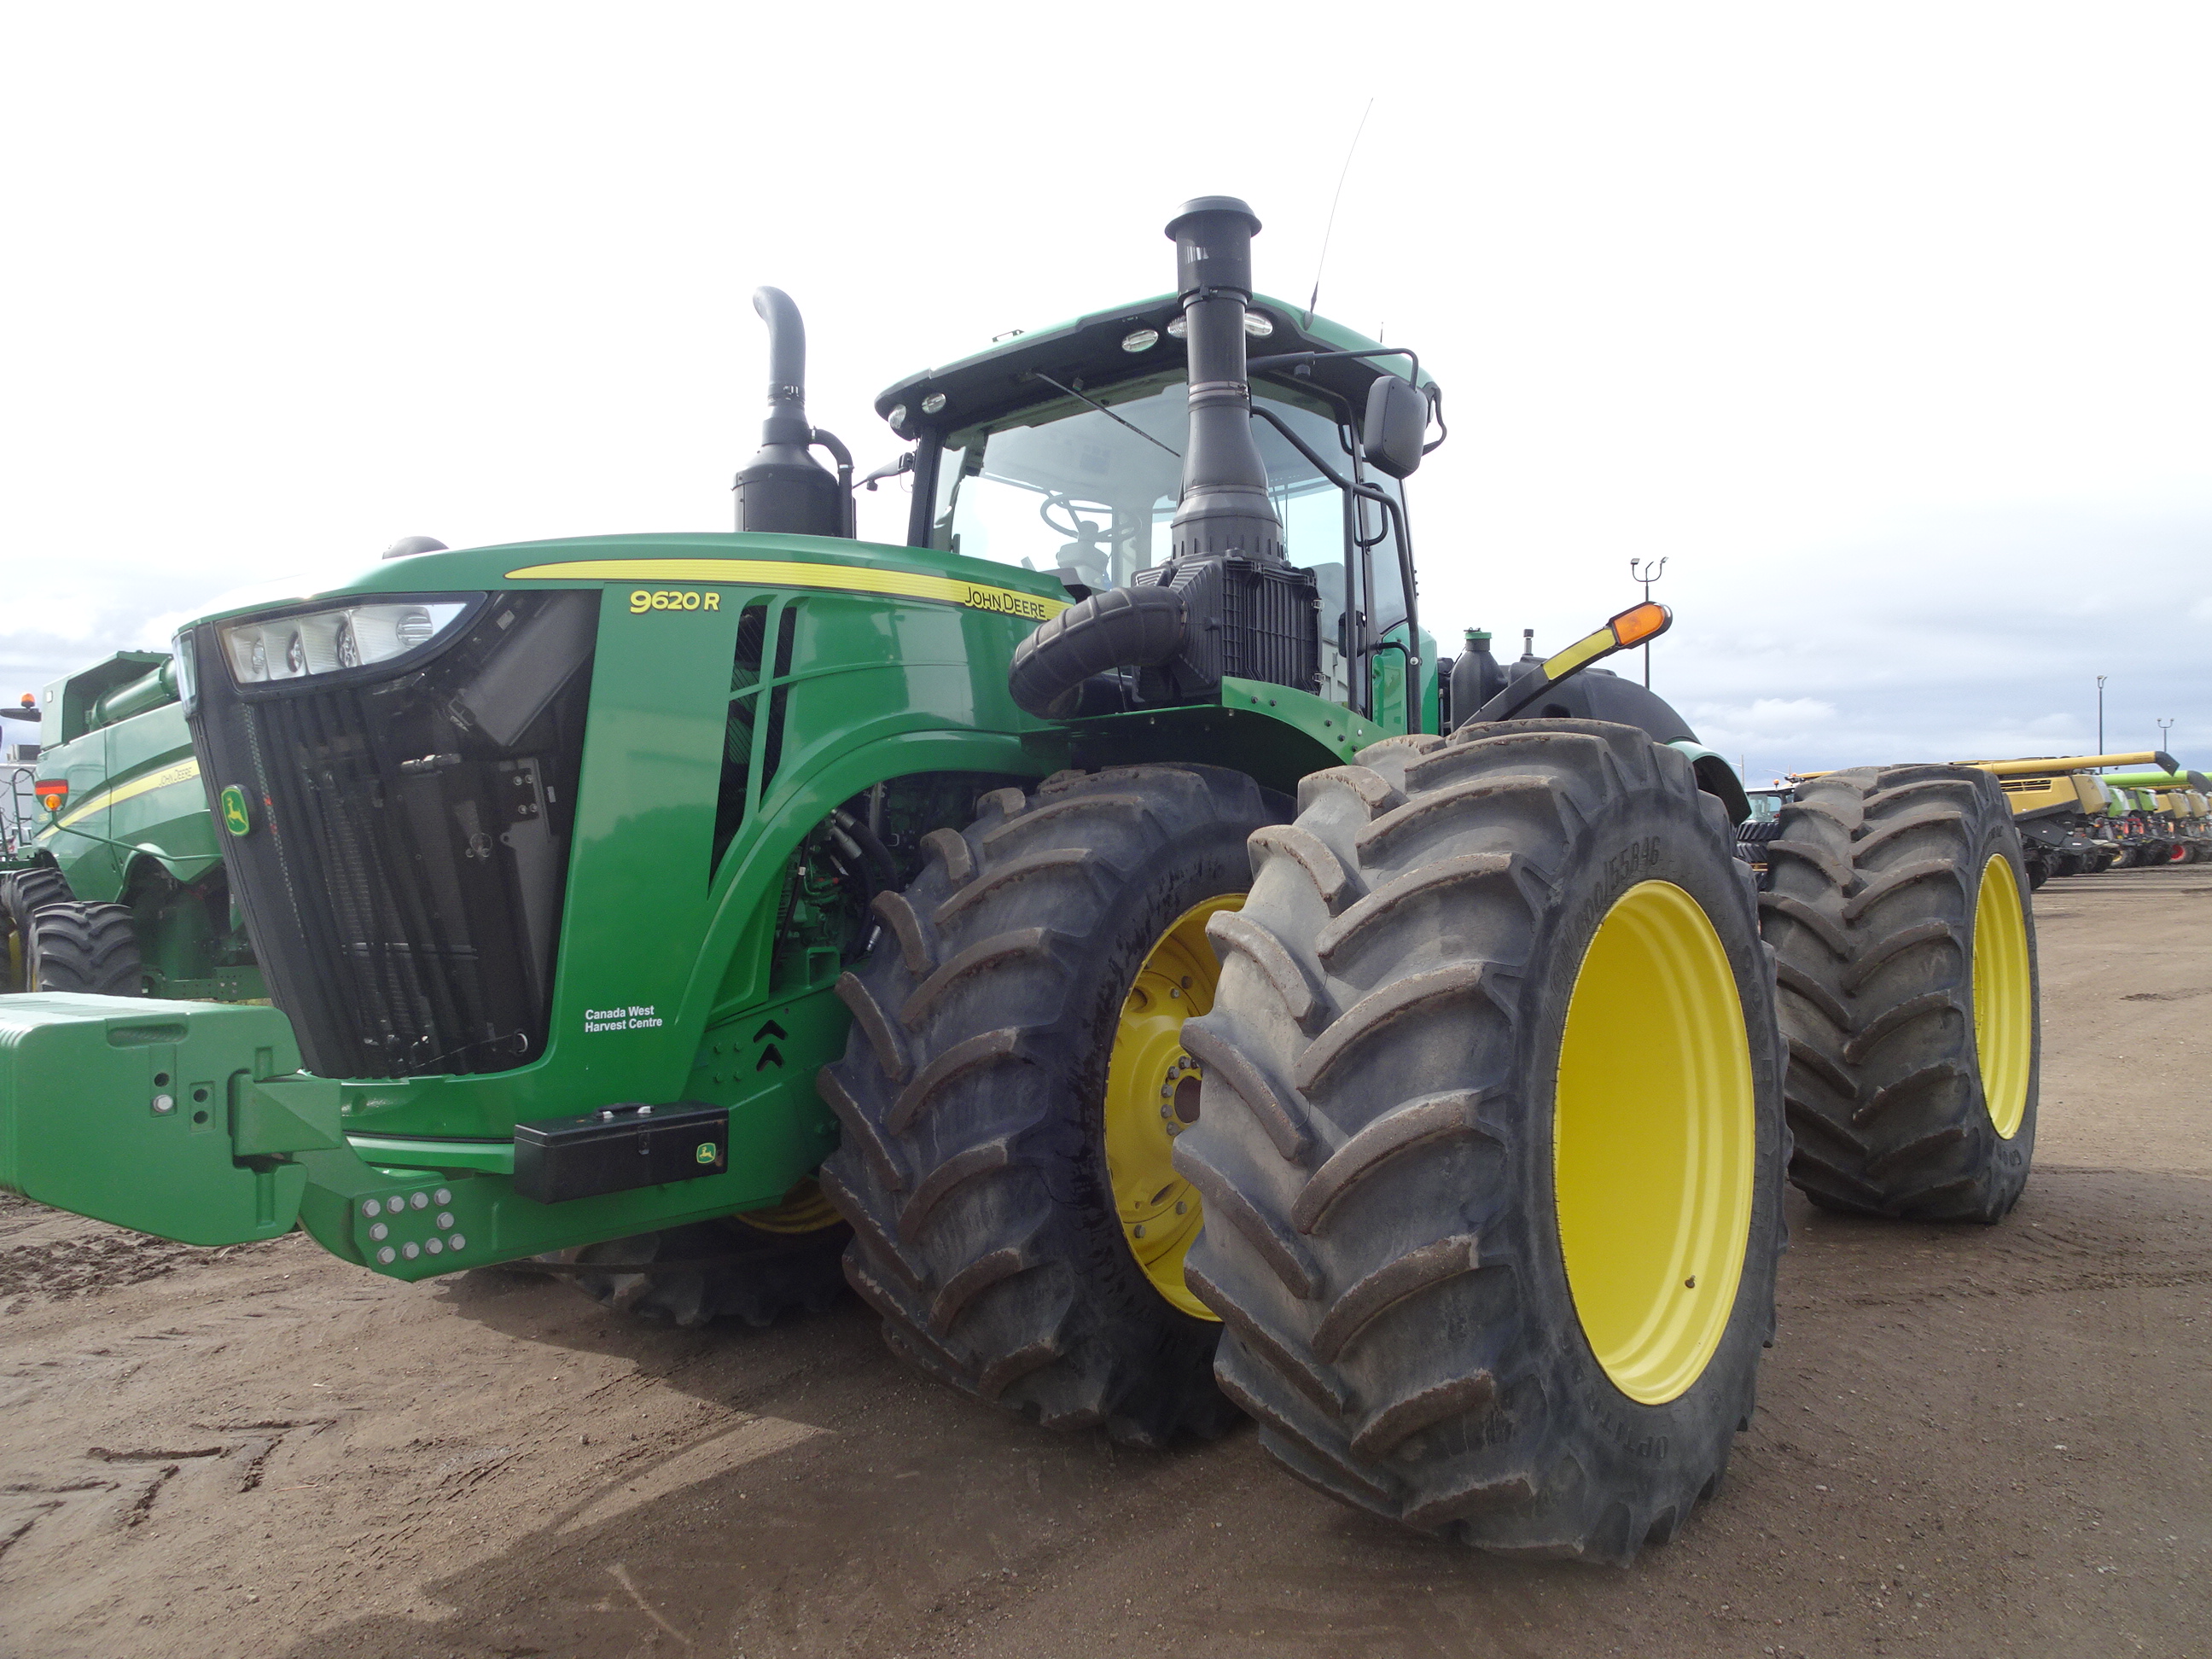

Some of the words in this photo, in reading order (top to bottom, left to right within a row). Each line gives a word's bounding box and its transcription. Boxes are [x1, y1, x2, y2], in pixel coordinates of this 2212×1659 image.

[964, 586, 1002, 609] JOHN
[1003, 593, 1047, 618] DEERE
[585, 1008, 626, 1020] Canada
[628, 1005, 655, 1016] West
[585, 1020, 626, 1033] Harvest
[629, 1017, 663, 1029] Centre
